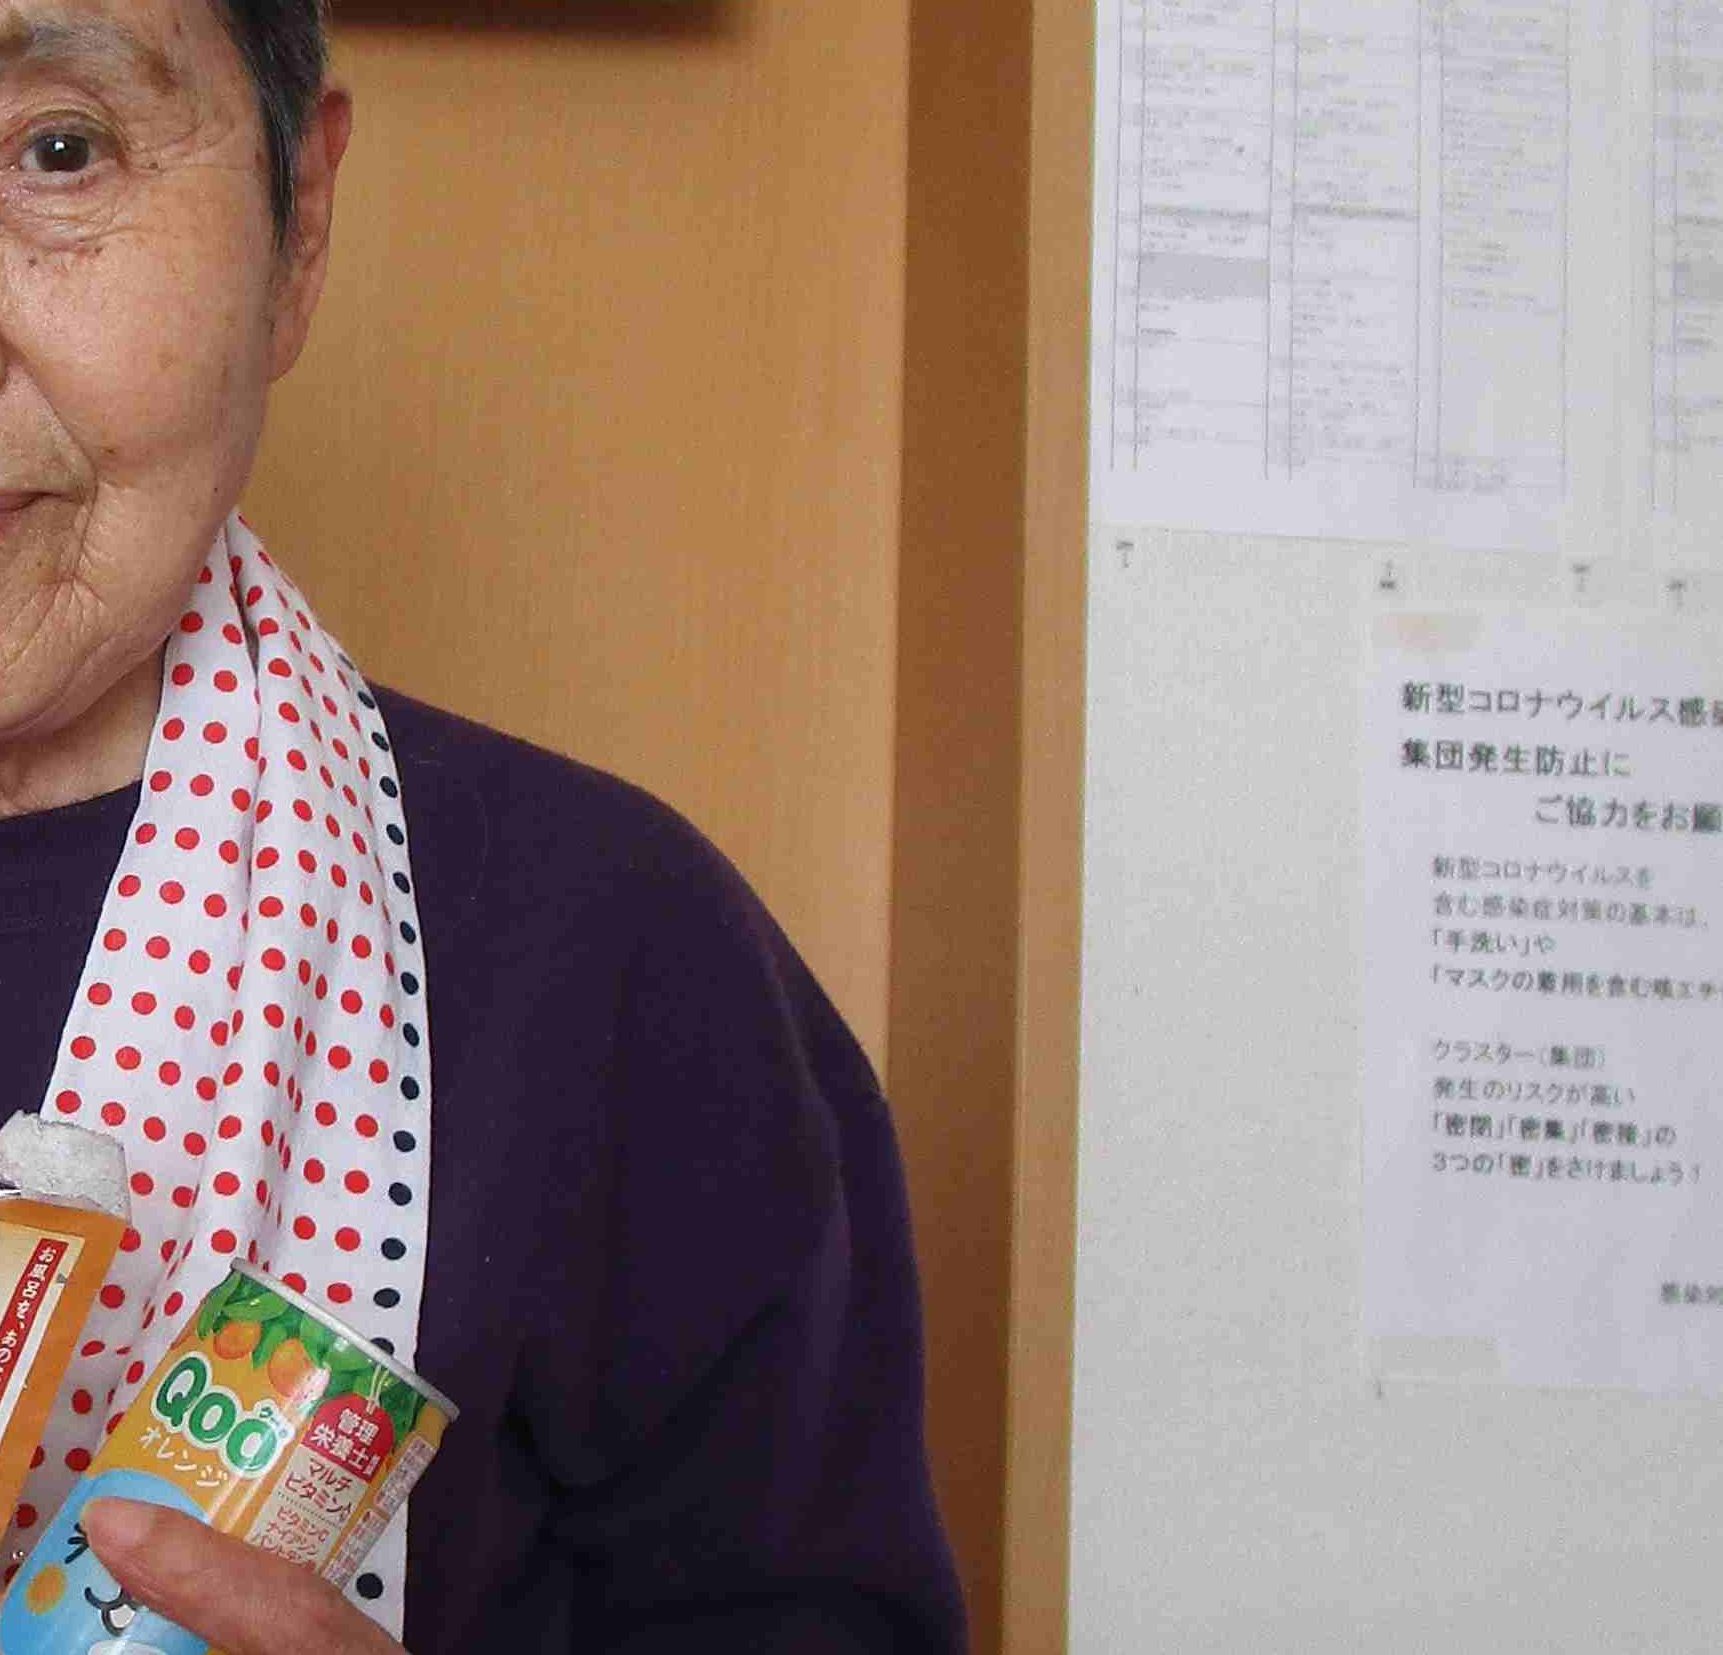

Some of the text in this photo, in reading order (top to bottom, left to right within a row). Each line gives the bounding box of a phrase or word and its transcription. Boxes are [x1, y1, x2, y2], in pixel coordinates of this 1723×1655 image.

[1401, 738, 1633, 778] 集団発生防止に
[338, 1407, 380, 1445] 管理
[308, 1457, 353, 1494] マルチ
